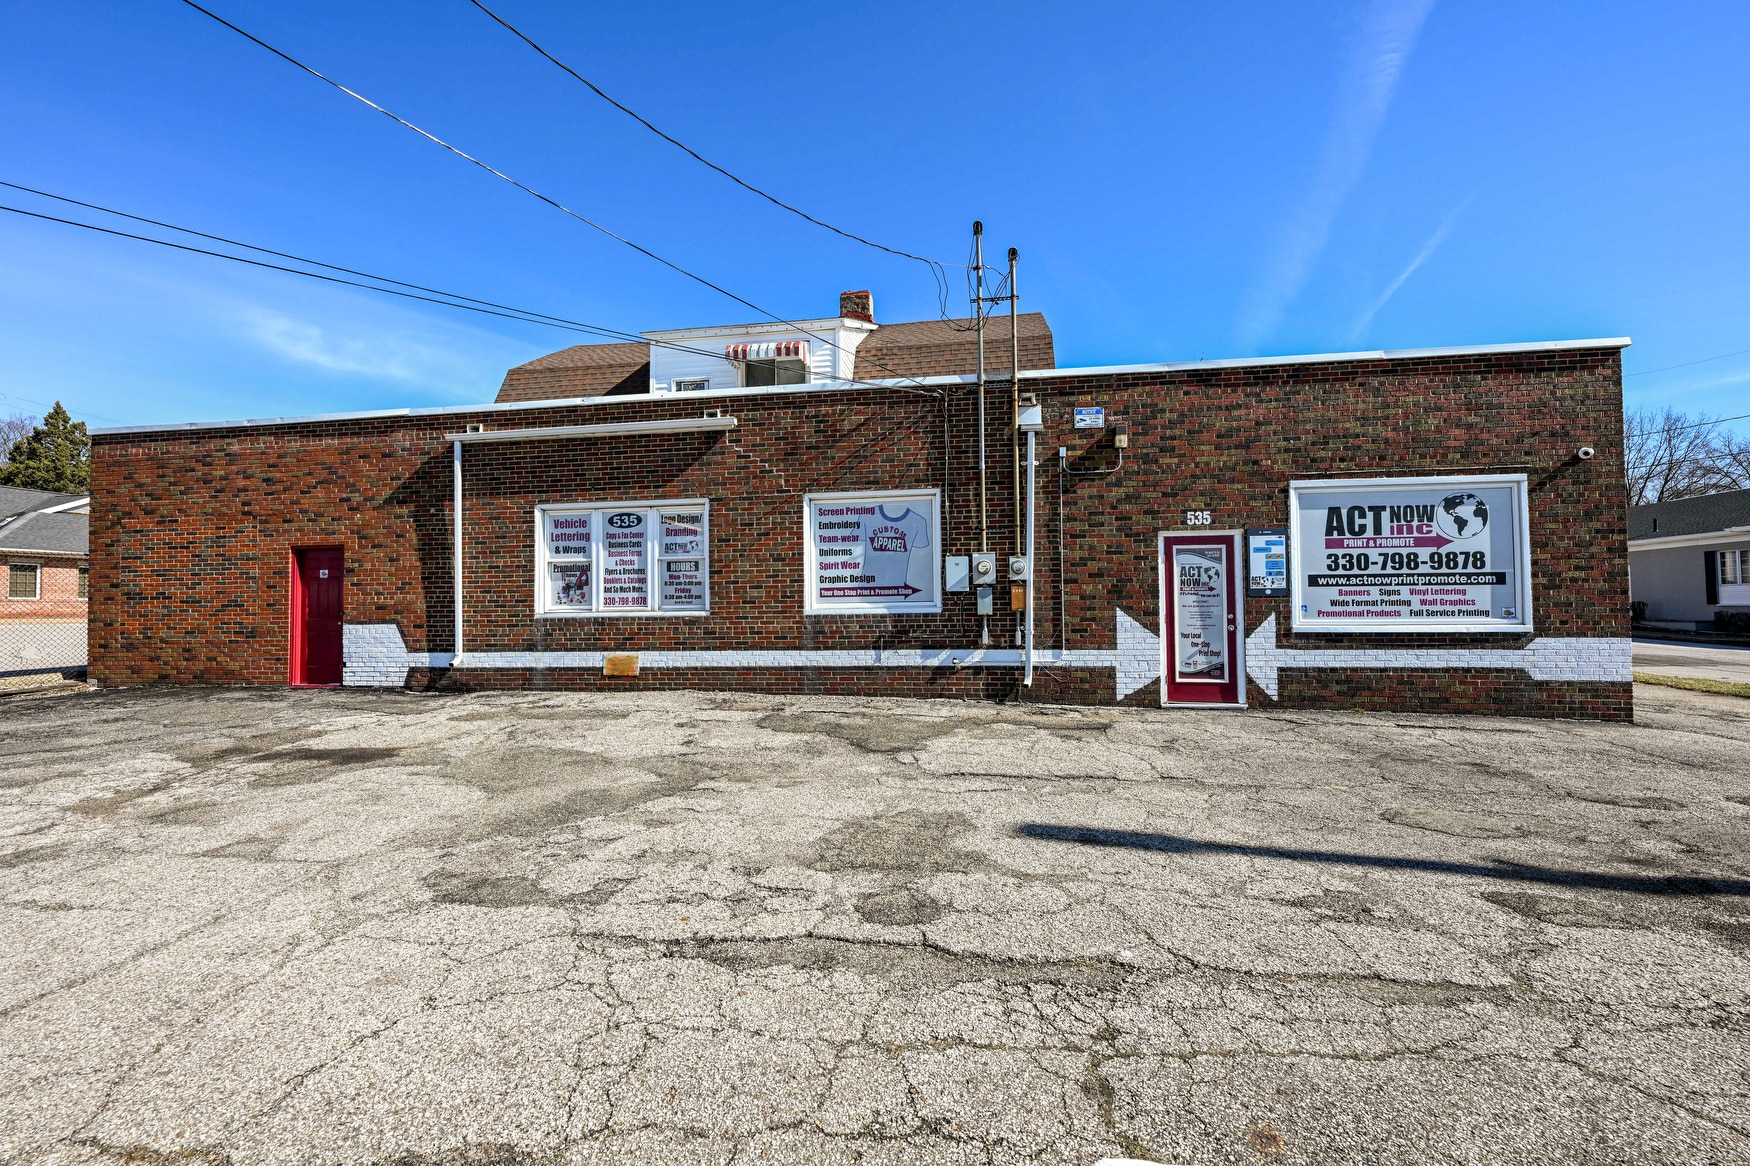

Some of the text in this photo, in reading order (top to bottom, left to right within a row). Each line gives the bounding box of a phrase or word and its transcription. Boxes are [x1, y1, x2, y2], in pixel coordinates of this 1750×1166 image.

[818, 506, 875, 516] Screen Printing
[613, 515, 638, 527] 535
[661, 513, 702, 525] Logo Design/
[1187, 511, 1212, 526] 535
[1325, 504, 1435, 537] ACT NOW
[554, 518, 588, 530] Vehicle
[818, 520, 860, 530] Embroidery
[666, 527, 698, 537] Branding
[872, 526, 907, 538] CUSTOM
[1390, 523, 1433, 536] inc
[550, 531, 590, 542] Lettering
[606, 532, 618, 540] Copy
[629, 531, 644, 539] Center
[818, 535, 859, 543] Team-wear
[629, 540, 642, 548] Cards
[665, 542, 678, 551] ACT
[872, 536, 905, 552] APPAREL
[1343, 538, 1415, 548] PRINT & PROMOTE
[554, 545, 587, 555] & Wraps
[819, 548, 853, 556] Uniforms
[819, 561, 860, 570] Spirit Wear
[1326, 550, 1486, 572] 330-798-9878
[553, 564, 590, 573] Promotional
[671, 562, 696, 571] HOURS
[605, 568, 618, 576] Flyers
[623, 568, 645, 576] Brochures
[1180, 566, 1202, 578] ACT
[627, 576, 647, 585] Catalogs
[819, 574, 876, 584] Graphic Design
[1180, 578, 1200, 586] NOW
[1317, 573, 1497, 587] www.actnowprintpromote.com
[1338, 587, 1467, 597] Banners Signs Vinyl Lettering
[604, 597, 647, 605] 330-798-9878
[1330, 598, 1476, 608] Wide Format Printing Wall Graphics
[1317, 608, 1490, 618] Promotional Products Full Service Printing
